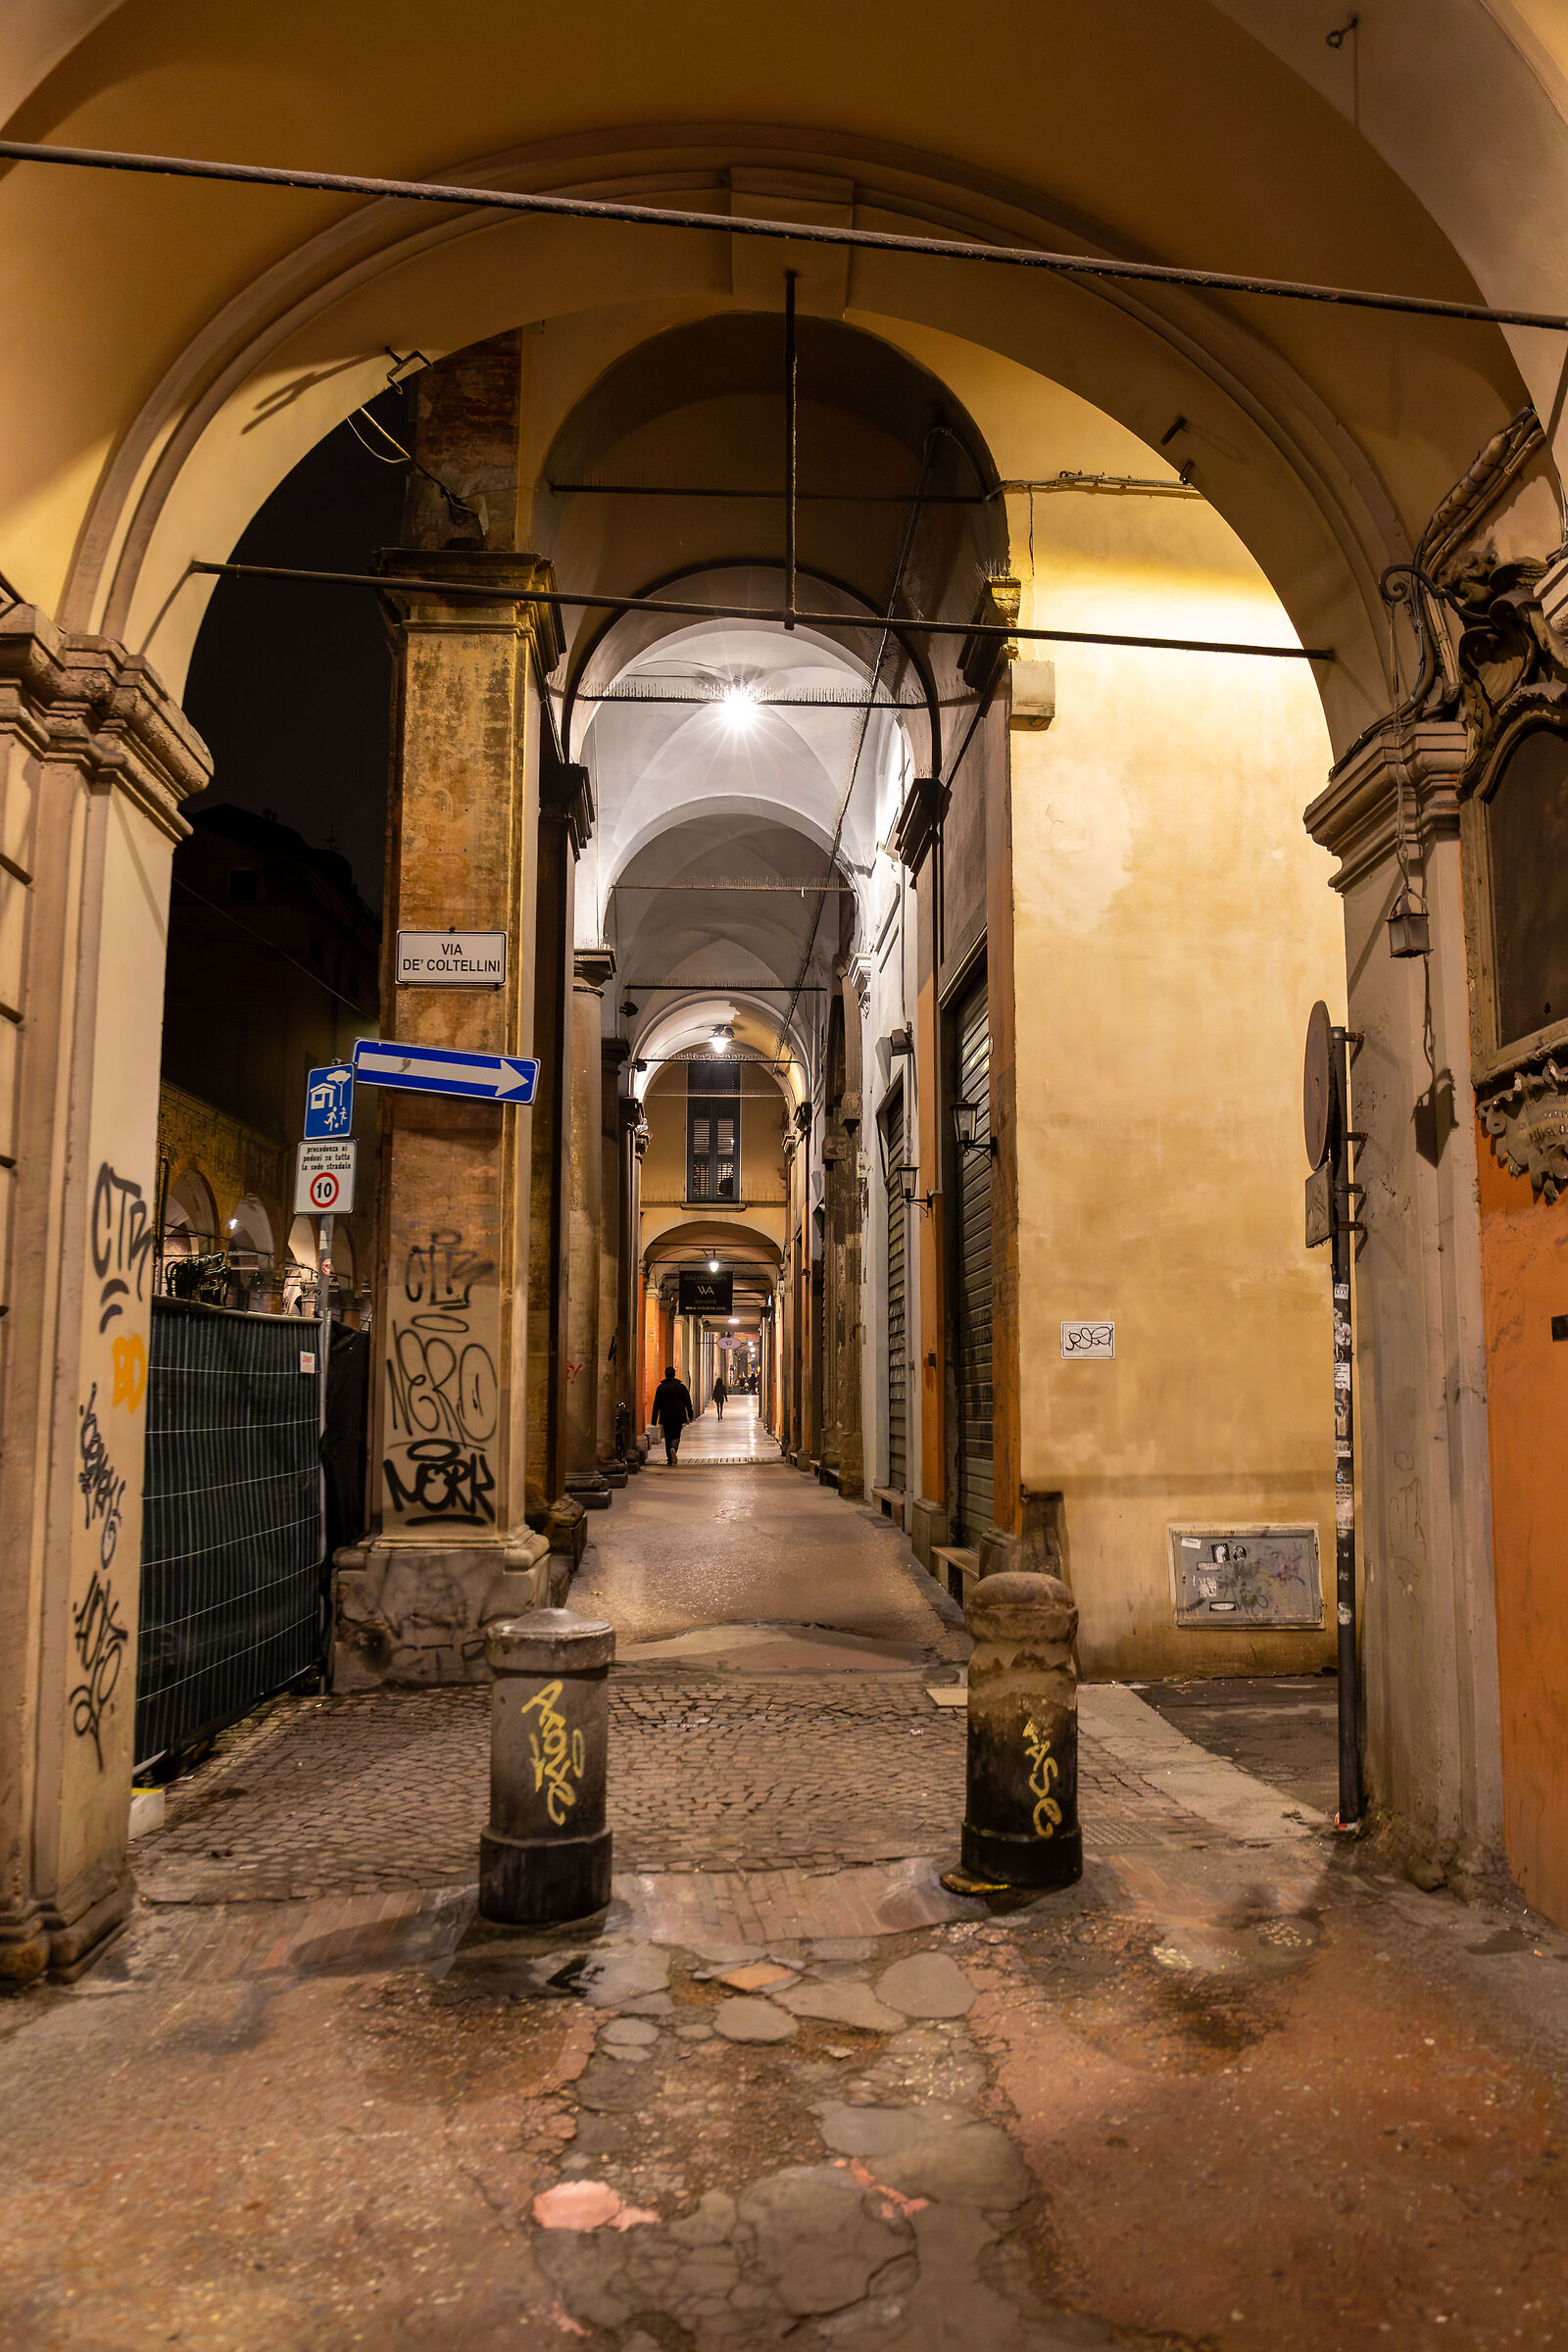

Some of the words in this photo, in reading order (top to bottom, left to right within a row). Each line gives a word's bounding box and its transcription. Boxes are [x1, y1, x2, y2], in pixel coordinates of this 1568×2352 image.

[441, 943, 463, 956] VIA
[426, 958, 501, 972] COLTELLINI
[307, 1145, 339, 1153] precedenza
[317, 1182, 332, 1199] 10
